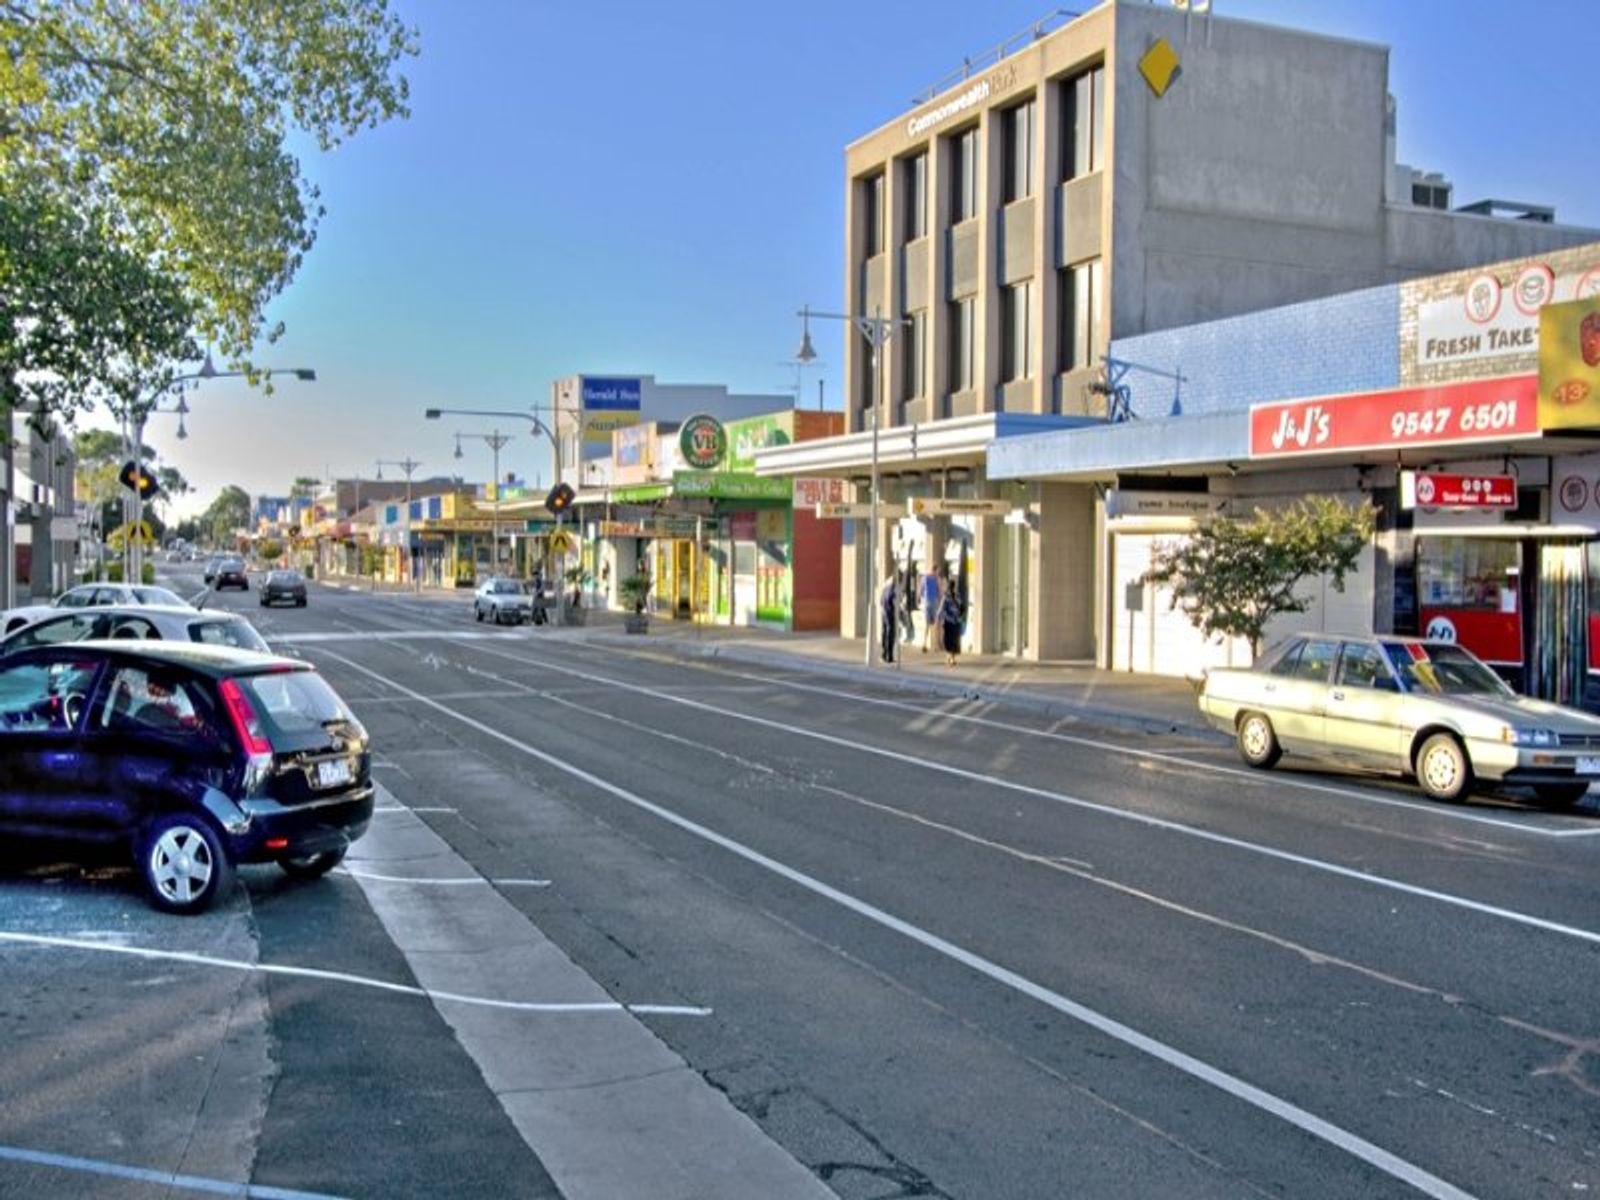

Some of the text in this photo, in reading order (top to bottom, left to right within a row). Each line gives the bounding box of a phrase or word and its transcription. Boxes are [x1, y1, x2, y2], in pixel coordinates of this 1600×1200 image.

[1426, 327, 1540, 359] FRESH TAKE
[584, 388, 617, 400] Herald
[1391, 408, 1451, 438] 9547
[1460, 401, 1517, 430] 6501
